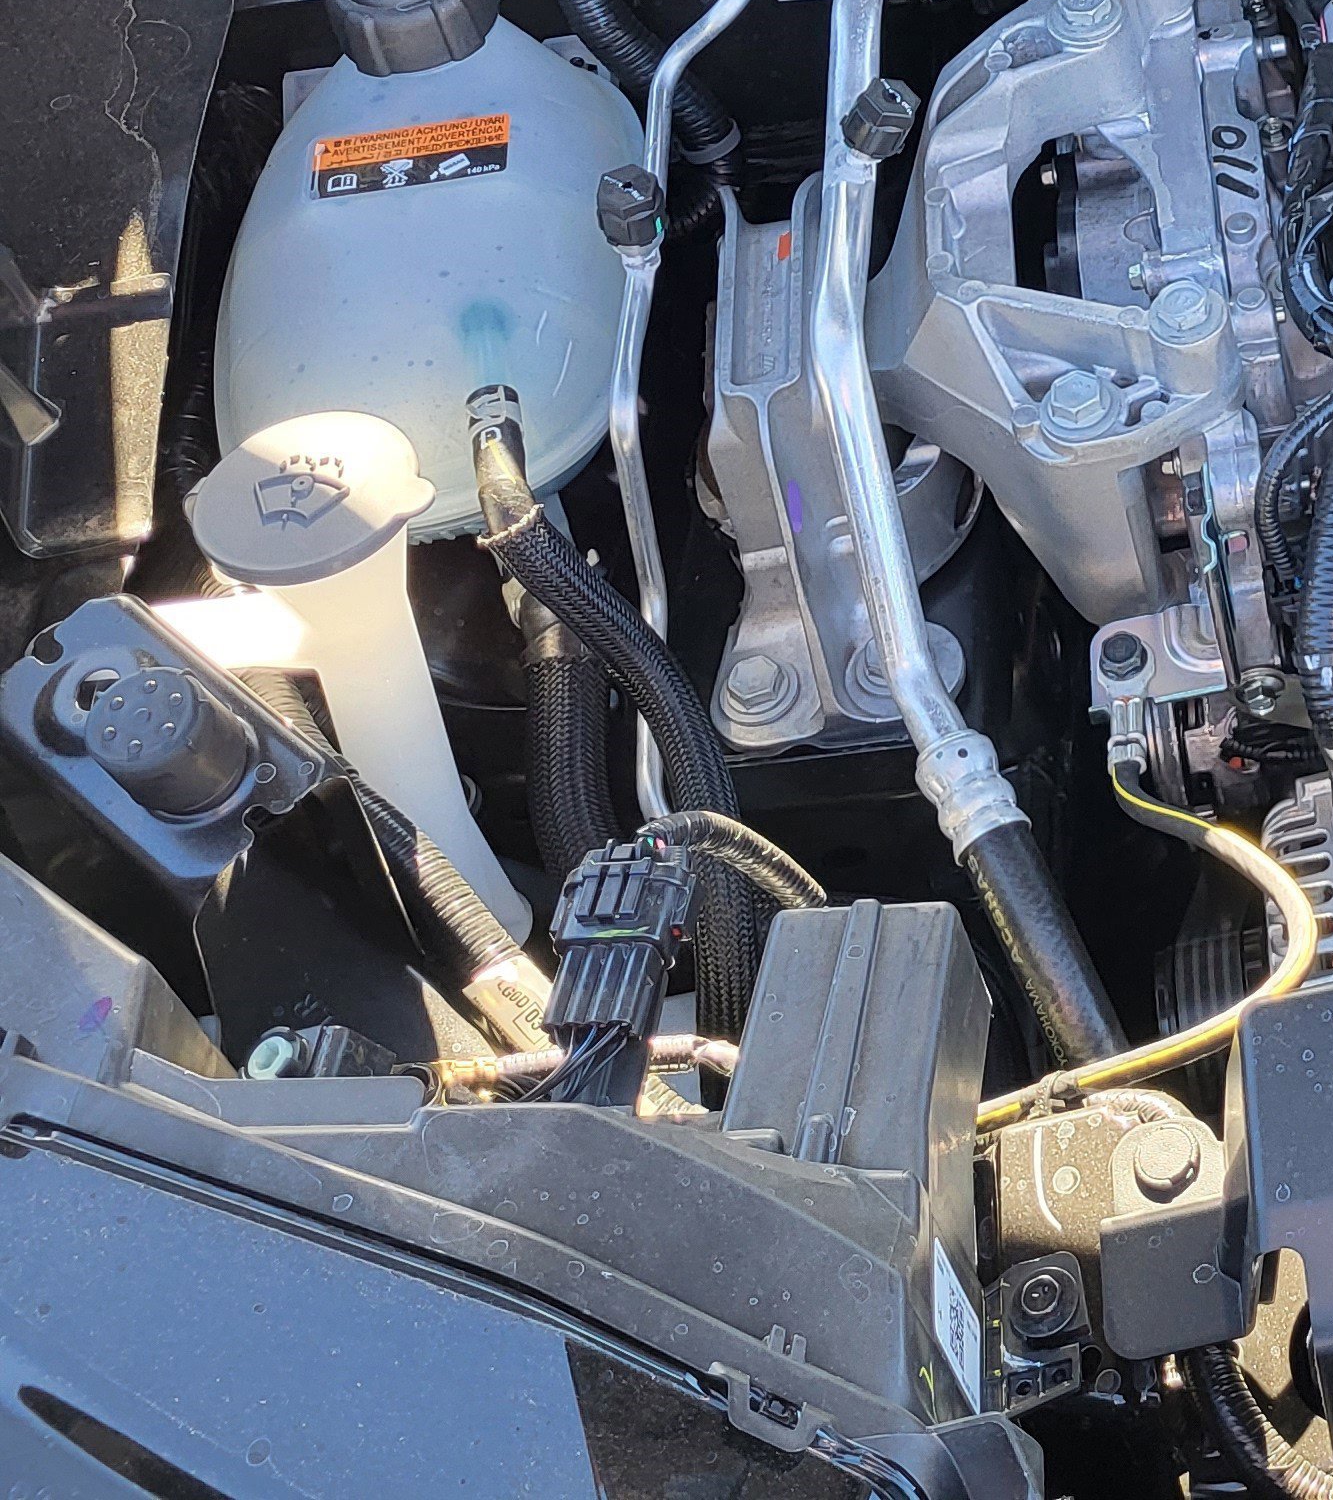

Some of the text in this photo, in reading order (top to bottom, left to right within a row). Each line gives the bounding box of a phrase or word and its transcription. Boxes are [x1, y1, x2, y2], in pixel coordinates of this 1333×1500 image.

[358, 129, 409, 144] WARNING
[415, 121, 469, 136] ACHTUNG
[330, 136, 423, 158] AVERTISSEMENT
[1022, 977, 1070, 1067] YOKOHAMA
